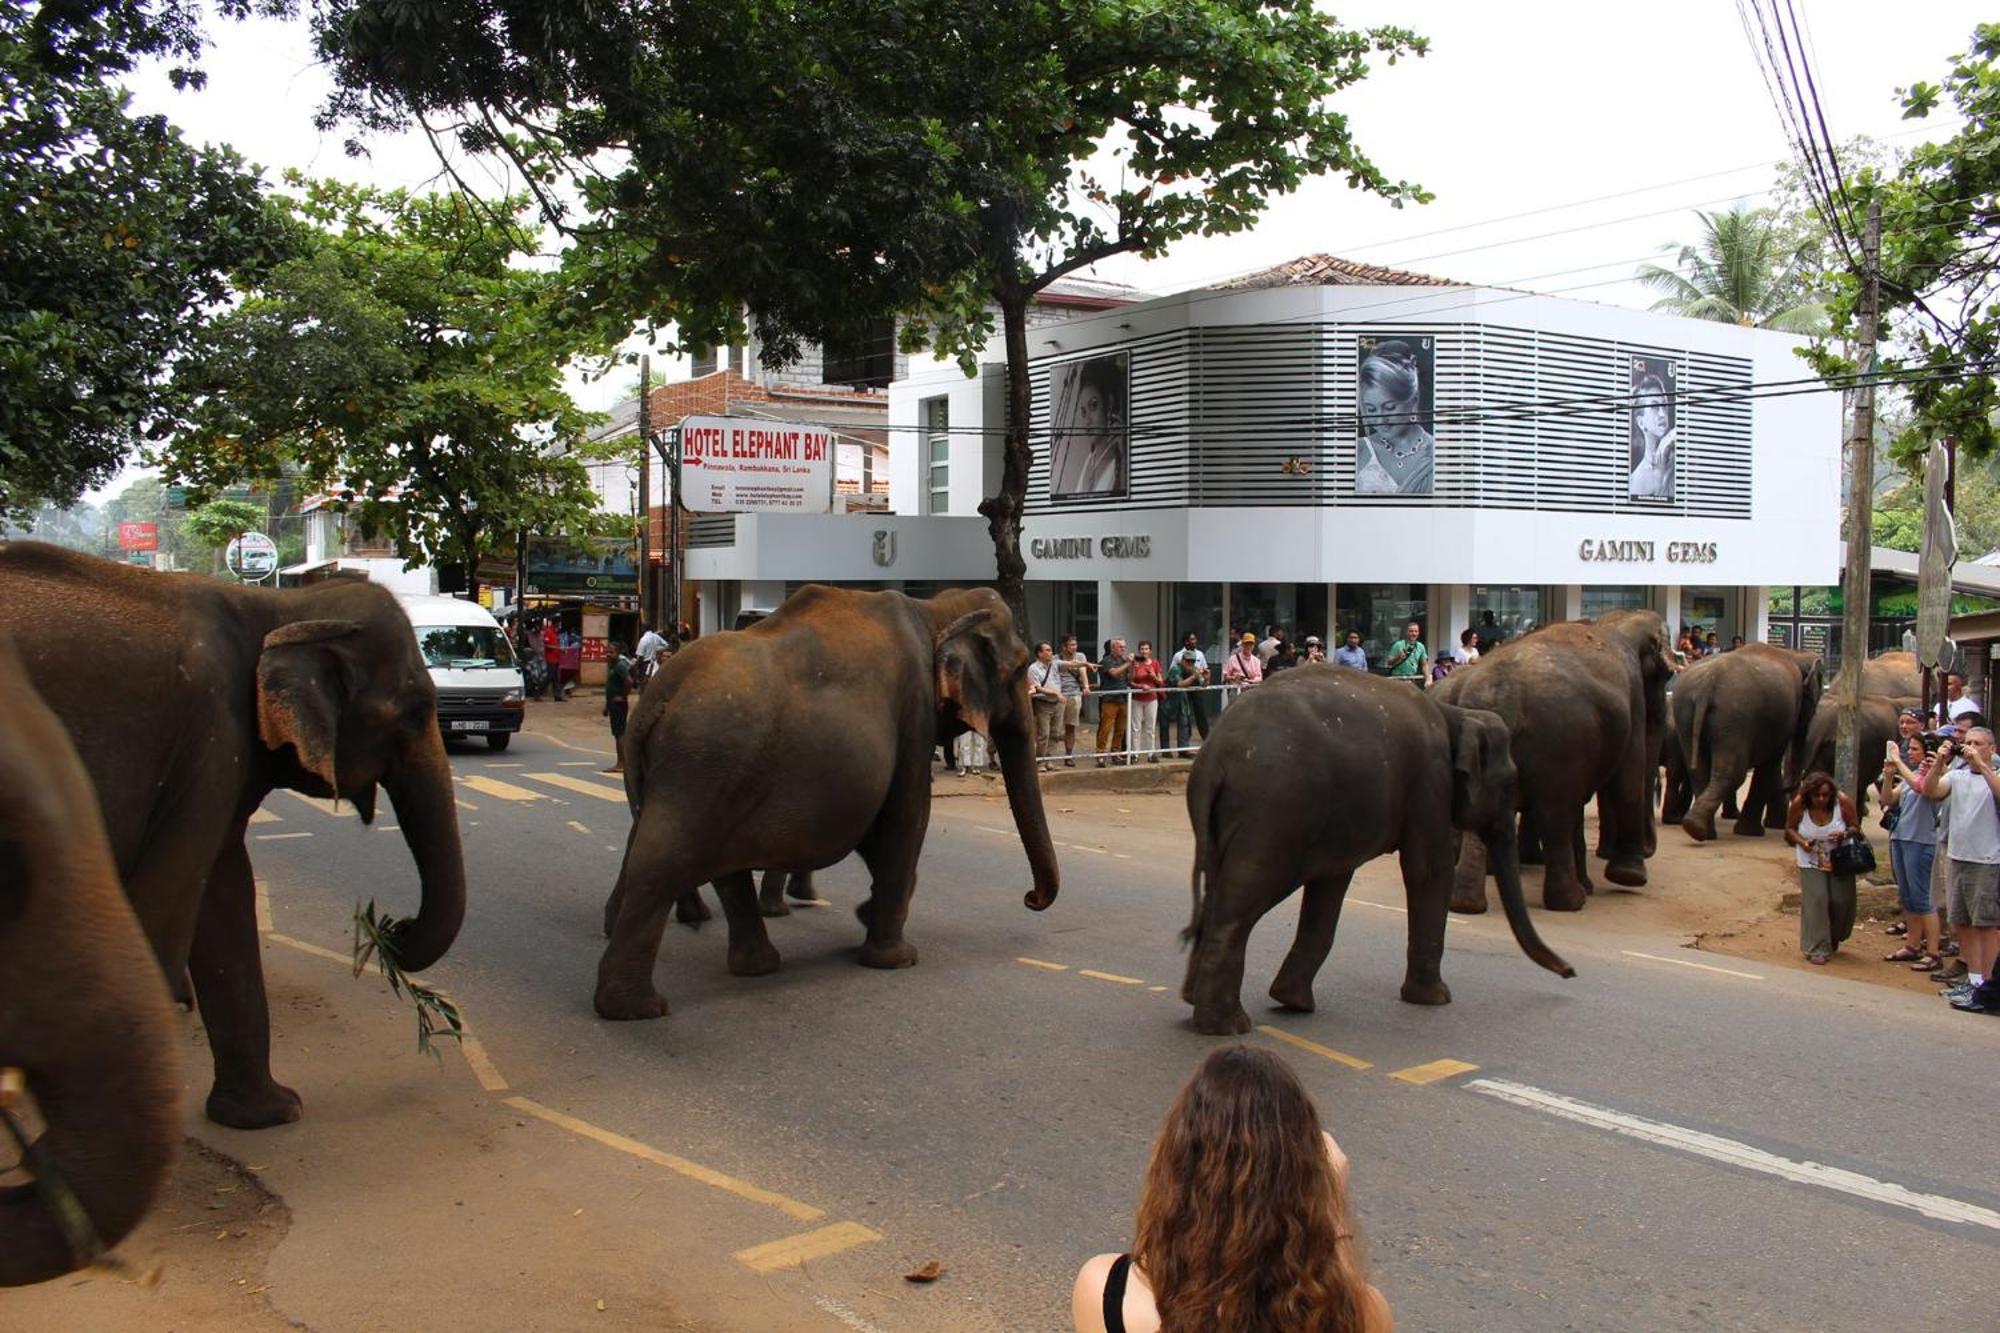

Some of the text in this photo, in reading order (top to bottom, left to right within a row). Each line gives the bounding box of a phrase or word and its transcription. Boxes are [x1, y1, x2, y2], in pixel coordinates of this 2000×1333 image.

[684, 428, 829, 461] HOTEL ELEPHANT BAY
[782, 465, 791, 474] Sri
[792, 466, 811, 474] Lanka
[1031, 536, 1151, 559] GAMINI GEMS
[1579, 539, 1718, 563] GAMINI GEMS
